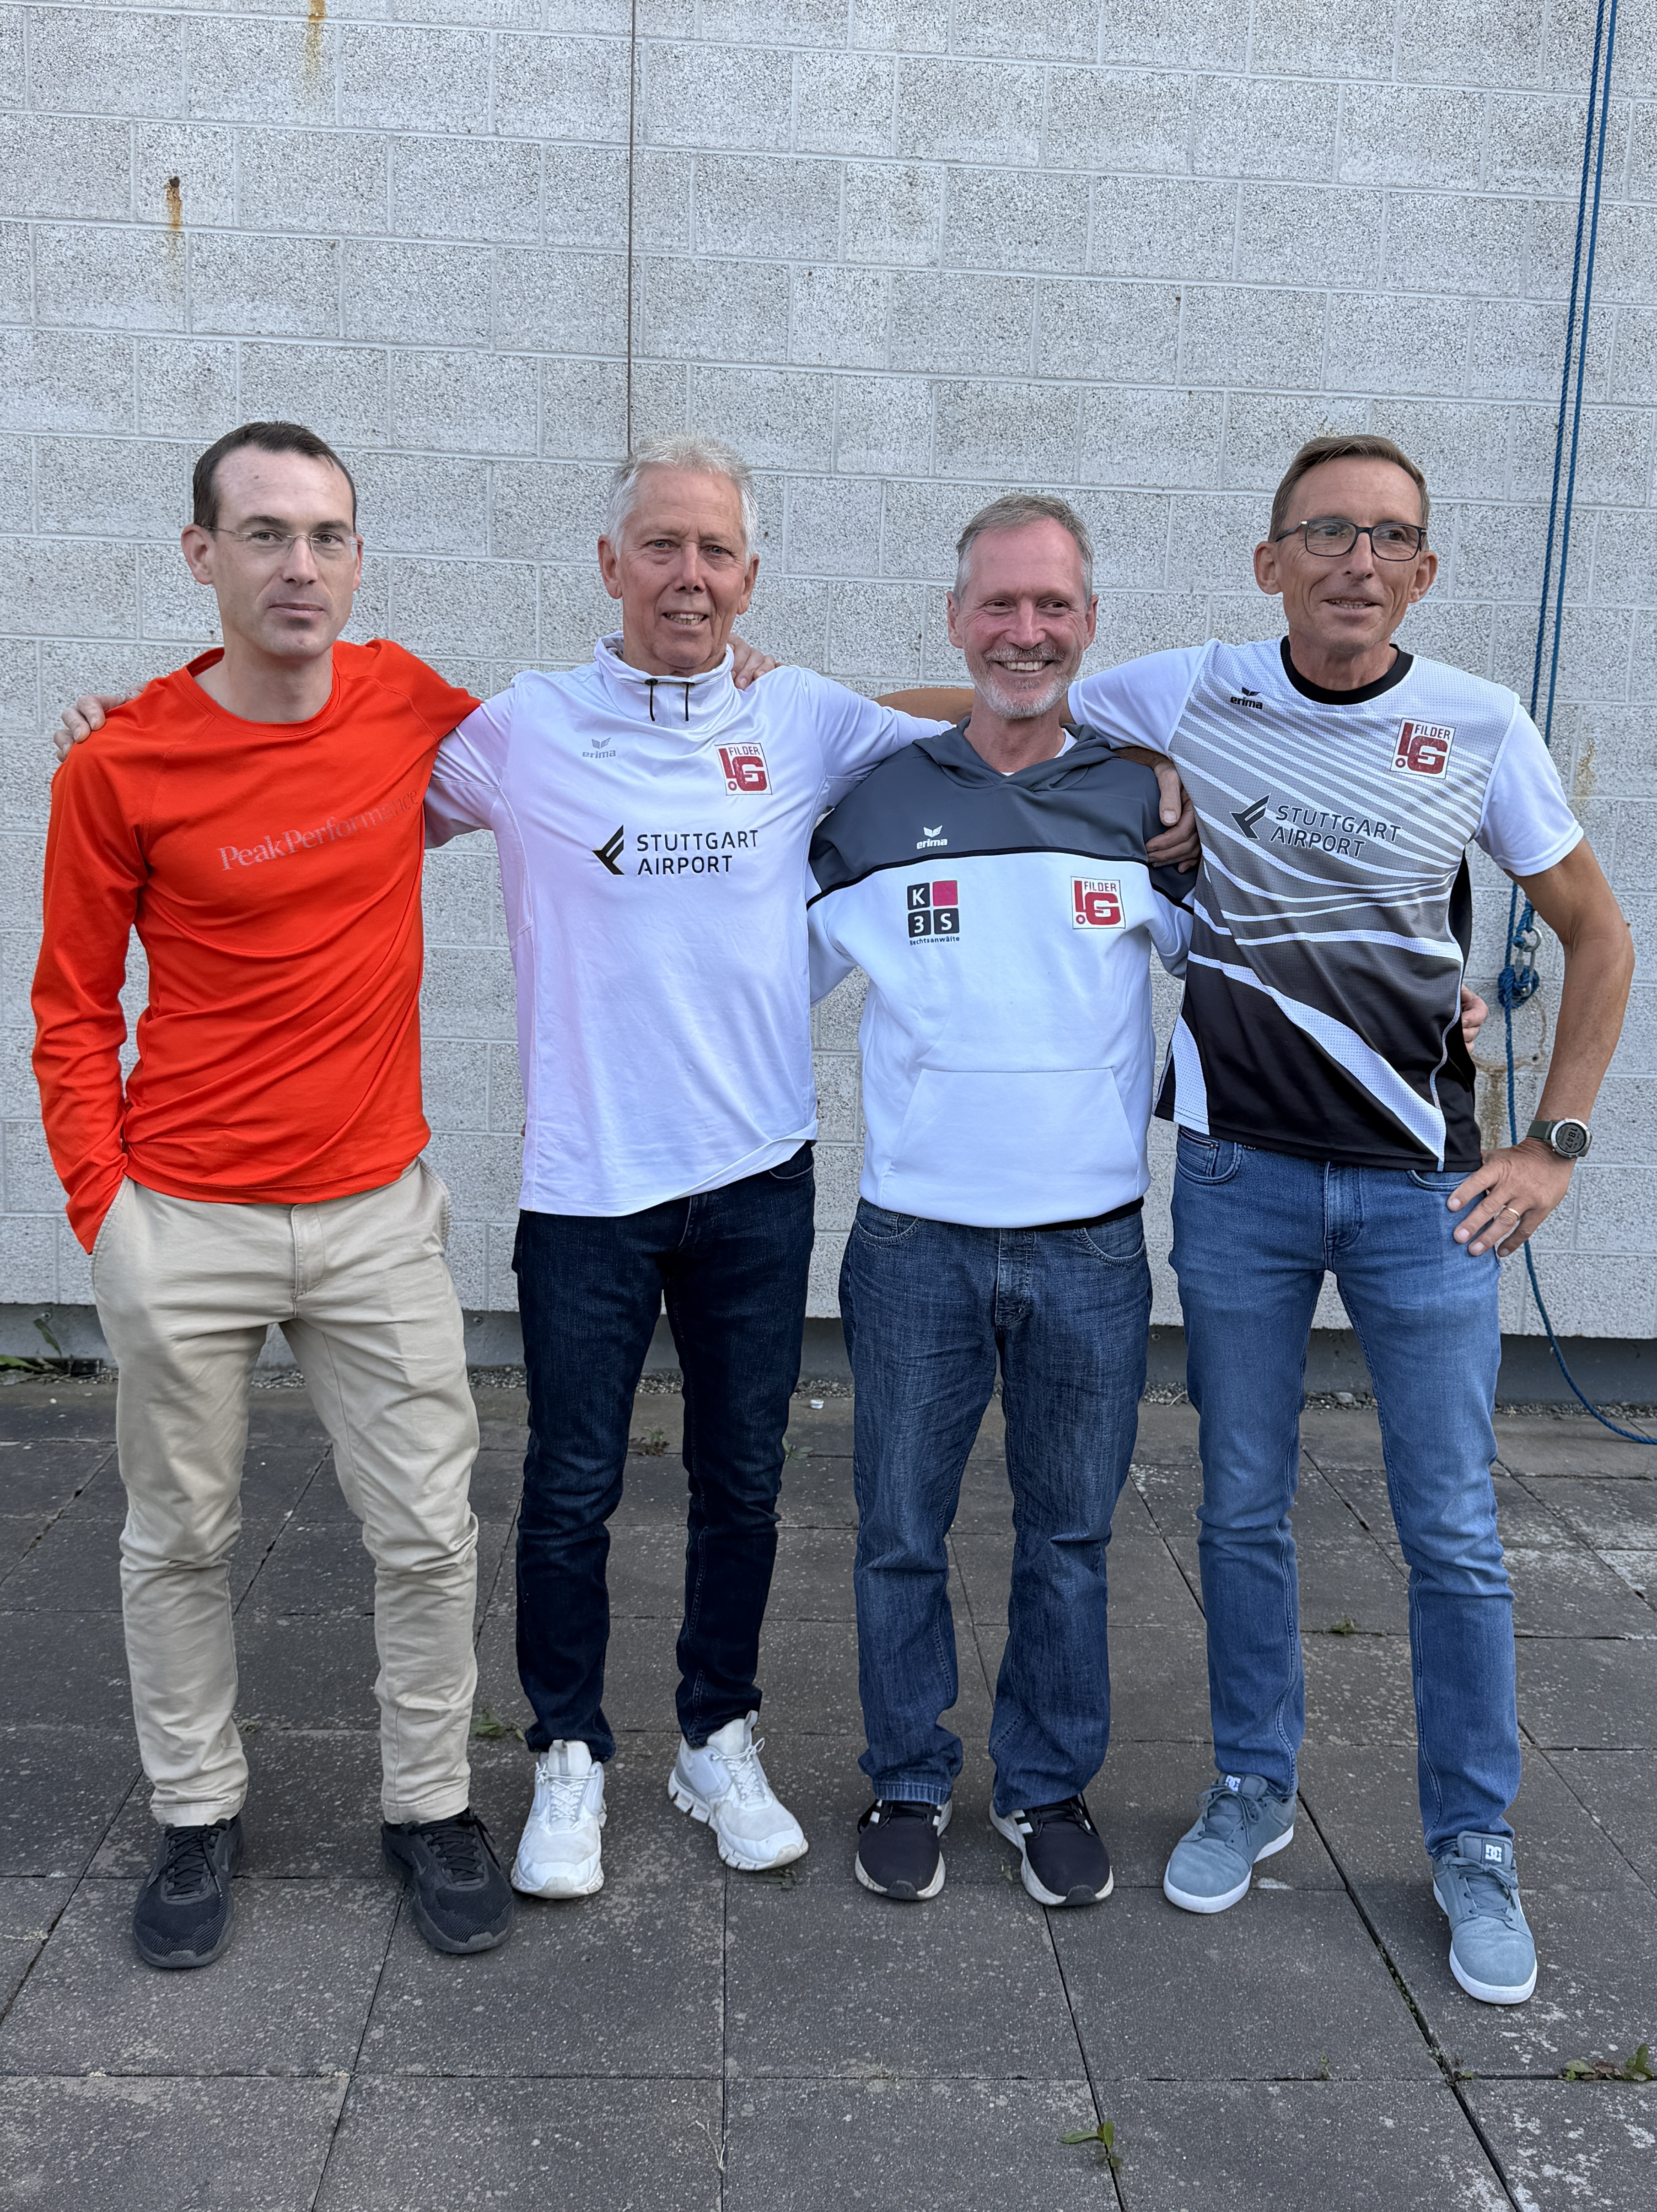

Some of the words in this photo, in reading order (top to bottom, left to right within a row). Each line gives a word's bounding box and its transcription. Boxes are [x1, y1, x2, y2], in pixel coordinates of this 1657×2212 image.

[1230, 696, 1263, 709] erima
[1414, 723, 1451, 740] FILDER
[582, 750, 616, 759] erima
[729, 745, 760, 756] FILDER
[1275, 804, 1402, 842] STUTTGART
[637, 829, 759, 852] STUTTGART
[916, 838, 948, 850] erima
[1270, 825, 1366, 858] AIRPORT
[637, 855, 732, 875] AIRPORT
[1084, 881, 1117, 892] FILDER
[913, 887, 925, 906] K
